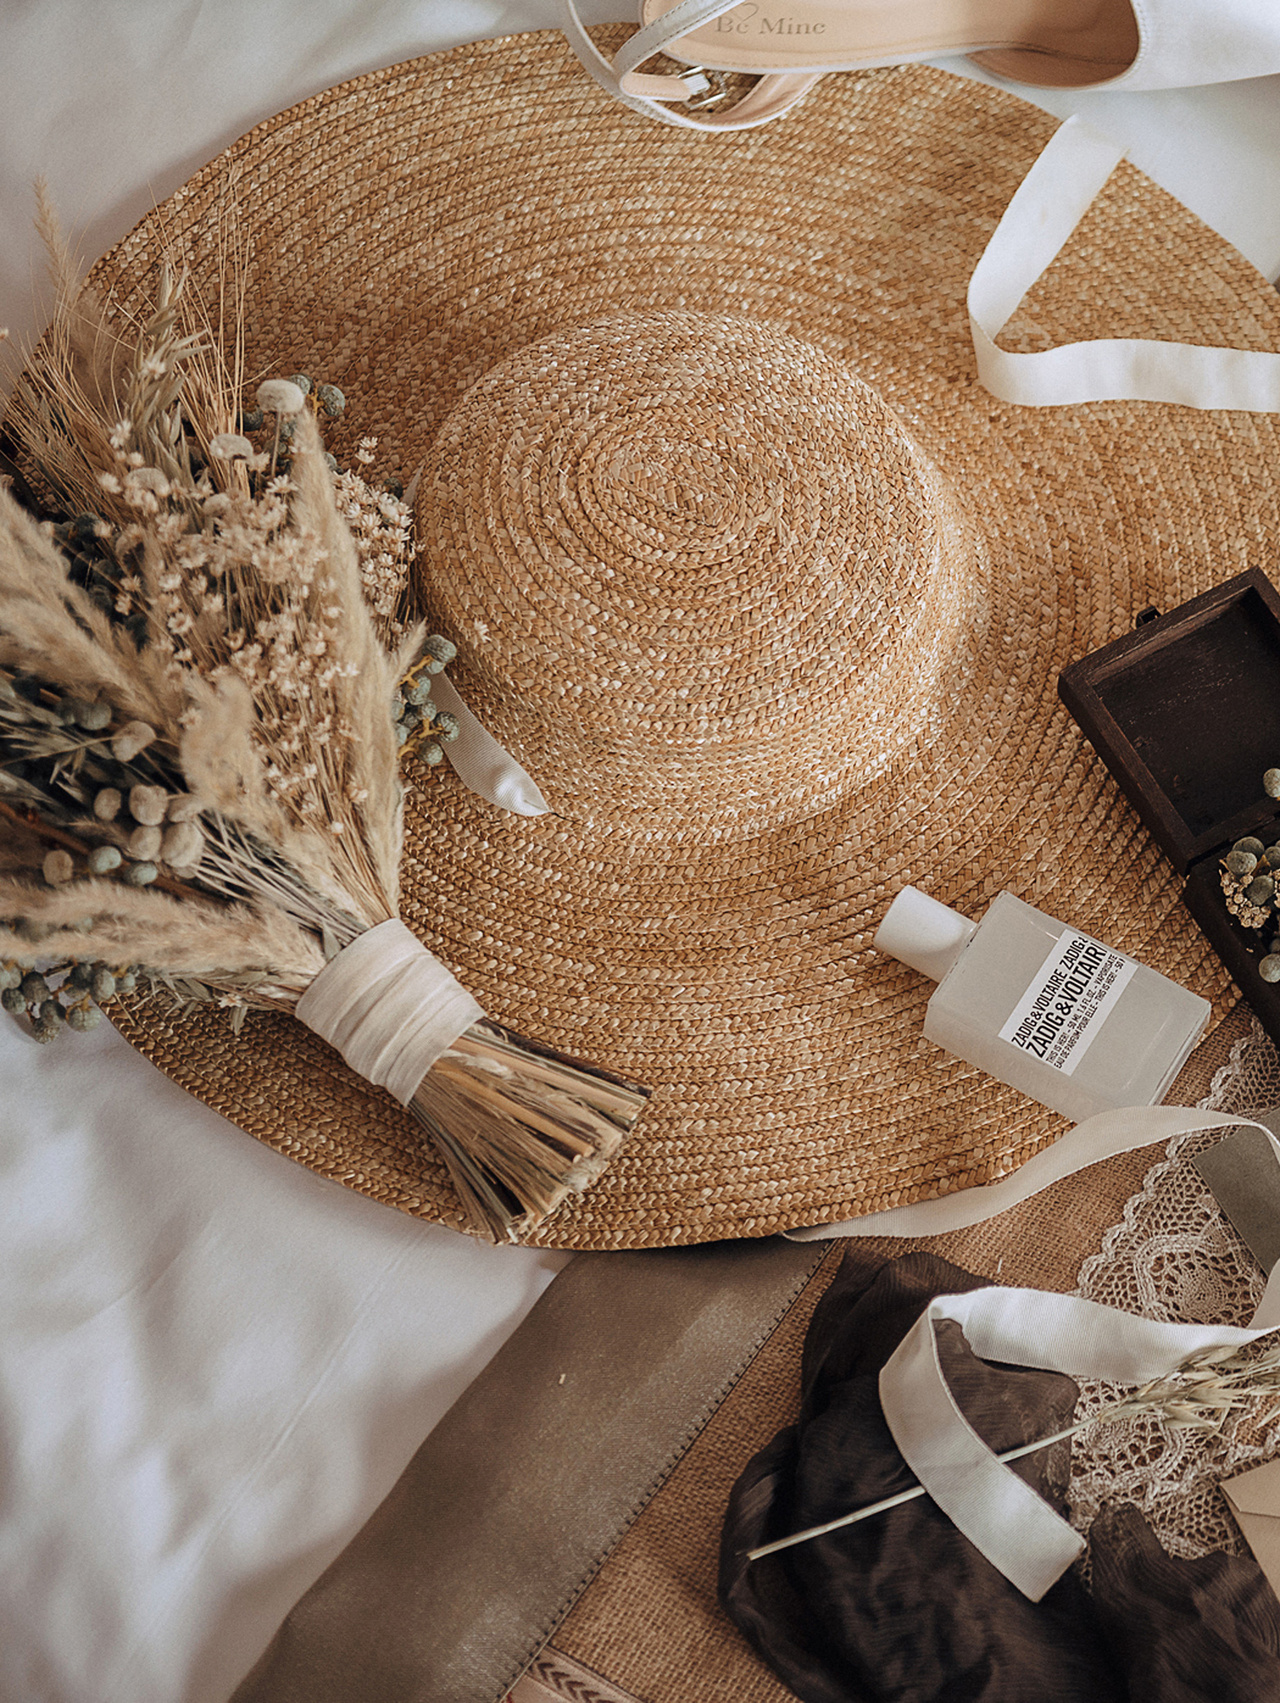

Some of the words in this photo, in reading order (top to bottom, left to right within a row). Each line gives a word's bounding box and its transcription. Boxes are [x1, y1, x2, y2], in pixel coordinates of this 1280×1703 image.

[715, 16, 749, 34] Be
[759, 17, 825, 35] Mine
[1054, 1059, 1065, 1069] EAU
[1060, 1050, 1070, 1059] DE
[1085, 1004, 1098, 1018] ELLE
[1094, 989, 1107, 1001] THIS
[1046, 1050, 1058, 1063] THIS
